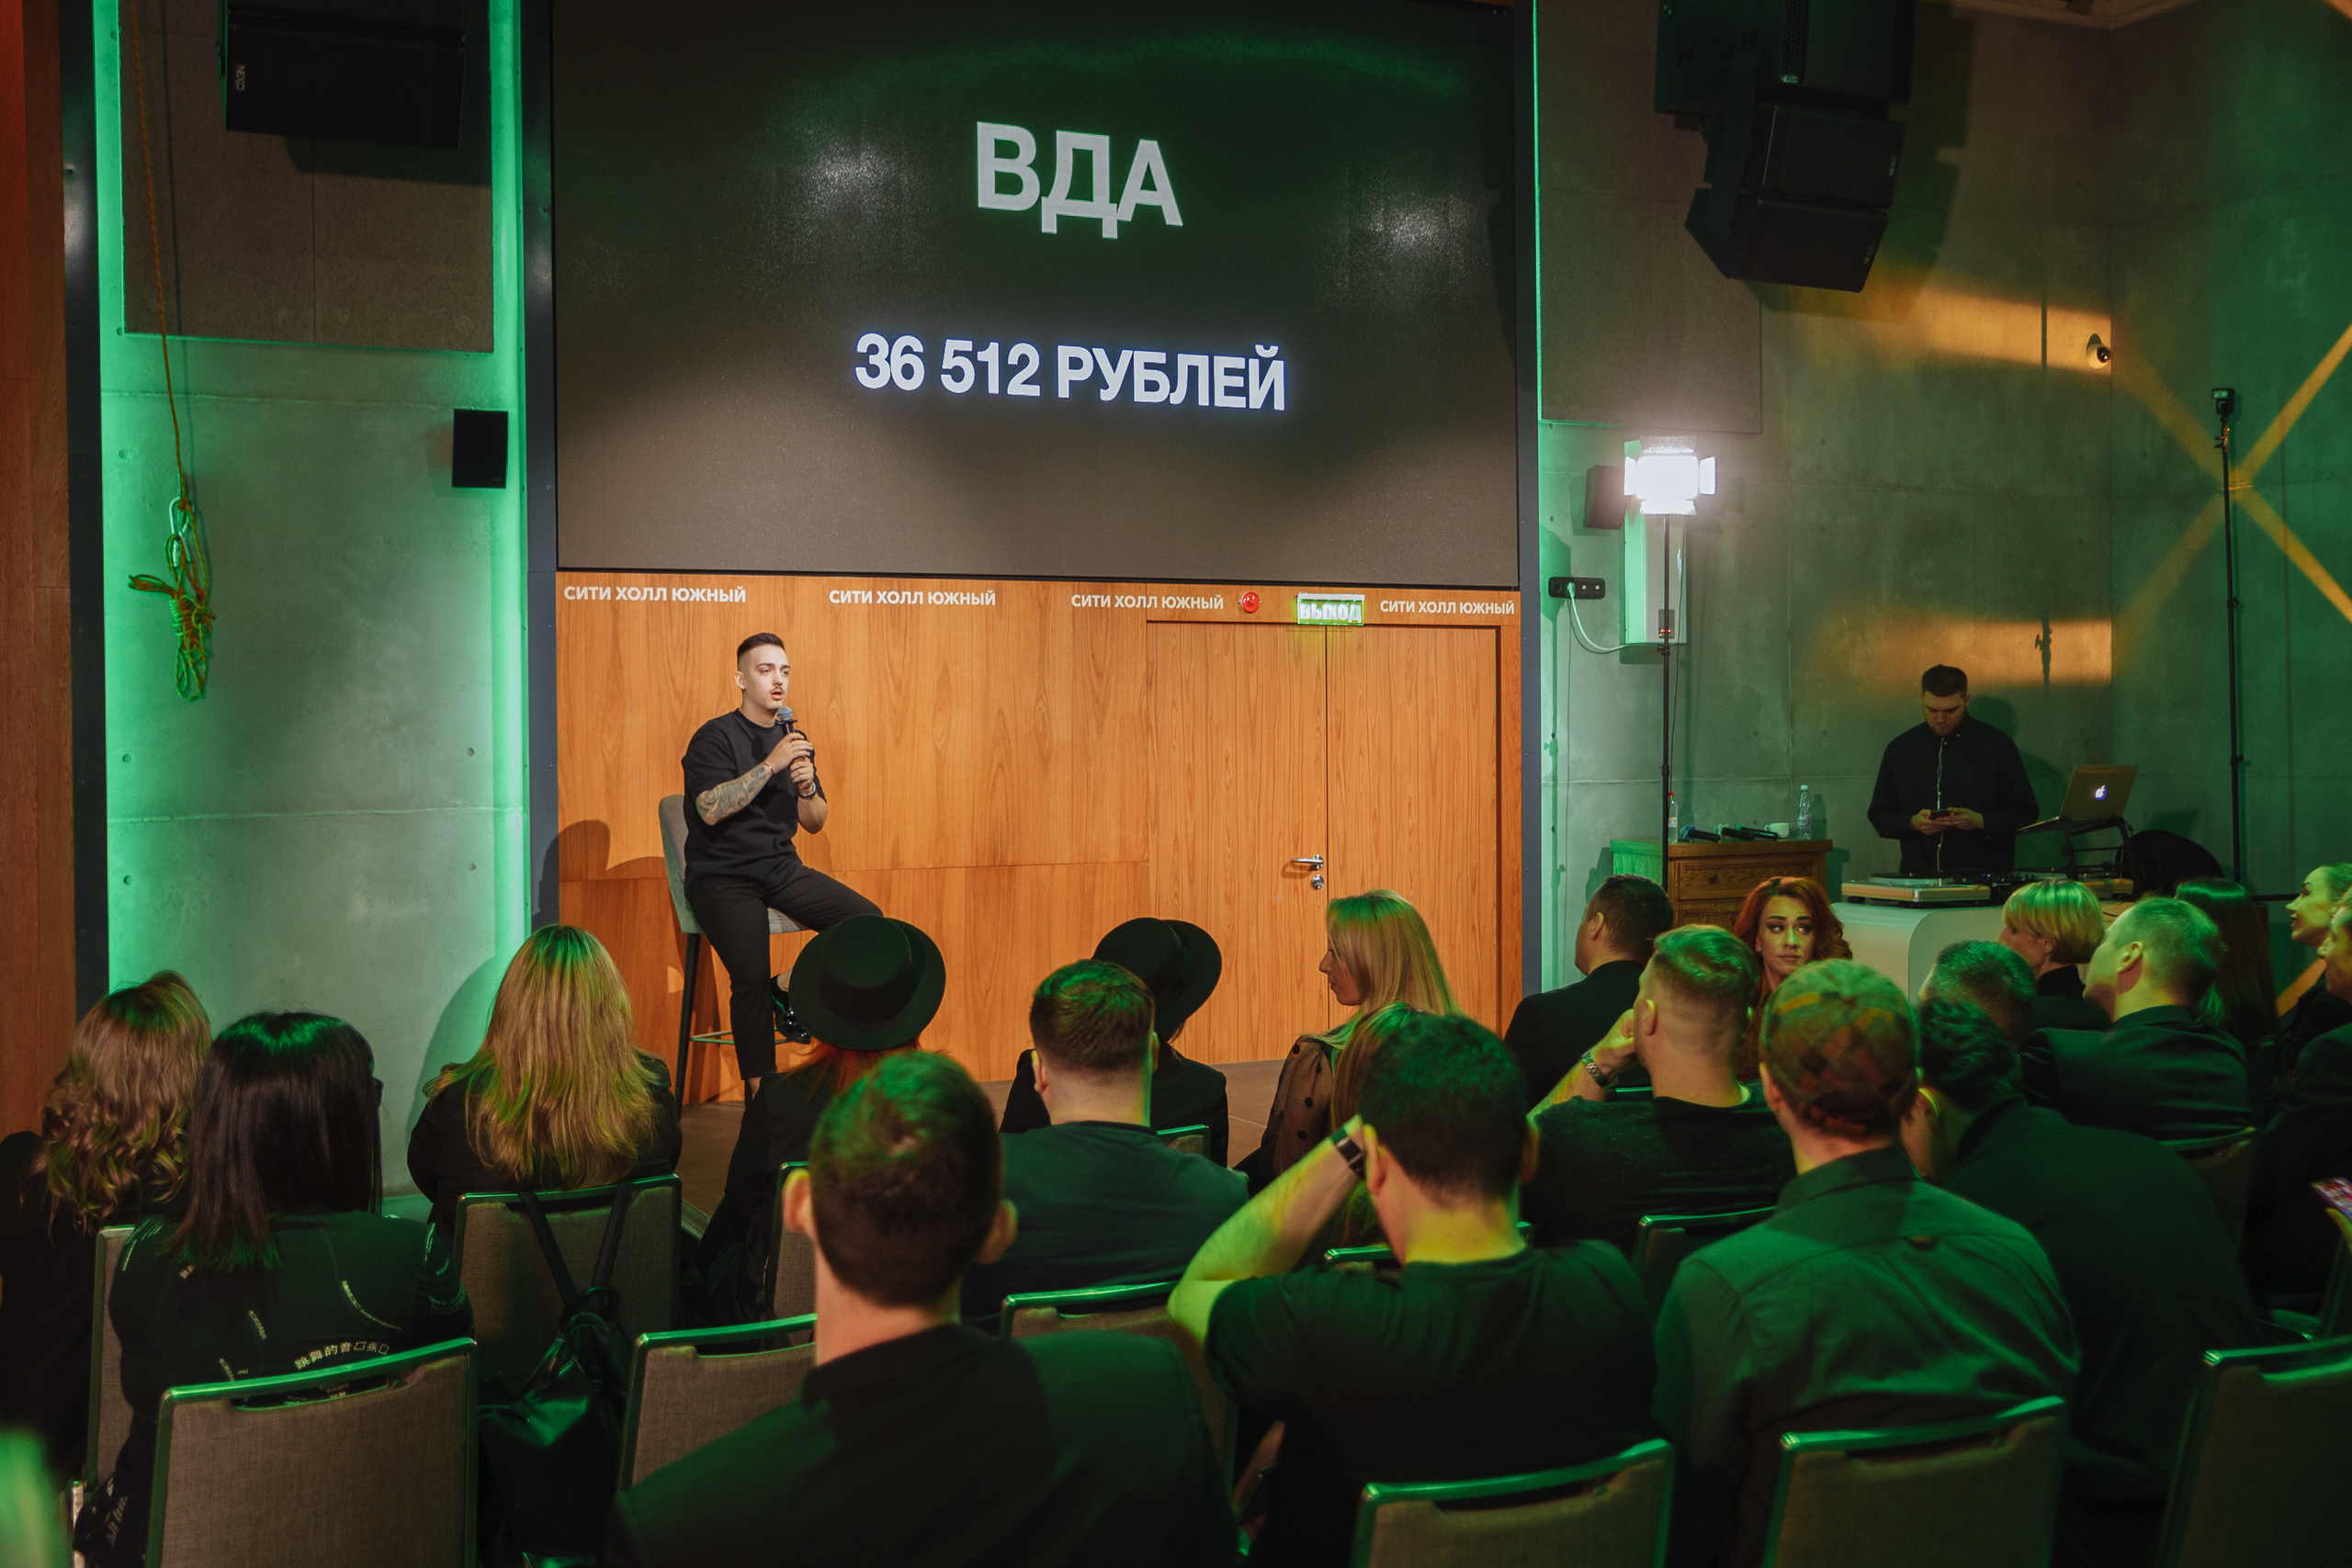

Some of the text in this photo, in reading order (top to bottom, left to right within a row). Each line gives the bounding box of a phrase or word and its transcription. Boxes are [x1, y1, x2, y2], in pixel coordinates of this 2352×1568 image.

[235, 65, 245, 91] NEXO
[977, 121, 1183, 239] ВДА
[855, 333, 1285, 411] 36 512 РУБЛЕЙ
[563, 585, 747, 604] СИТИ ХОЛЛ ЮЖНЫЙ
[829, 589, 996, 606] СИТИ ХОЛЛ ЮЖНЫЙ
[1070, 593, 1224, 610] СИТИ ХОЛЛ ЮЖНЫЙ
[1299, 603, 1363, 623] ВЫХОД
[1379, 600, 1515, 615] СИТИ ХОЛЛ ЮЖНЫЙ
